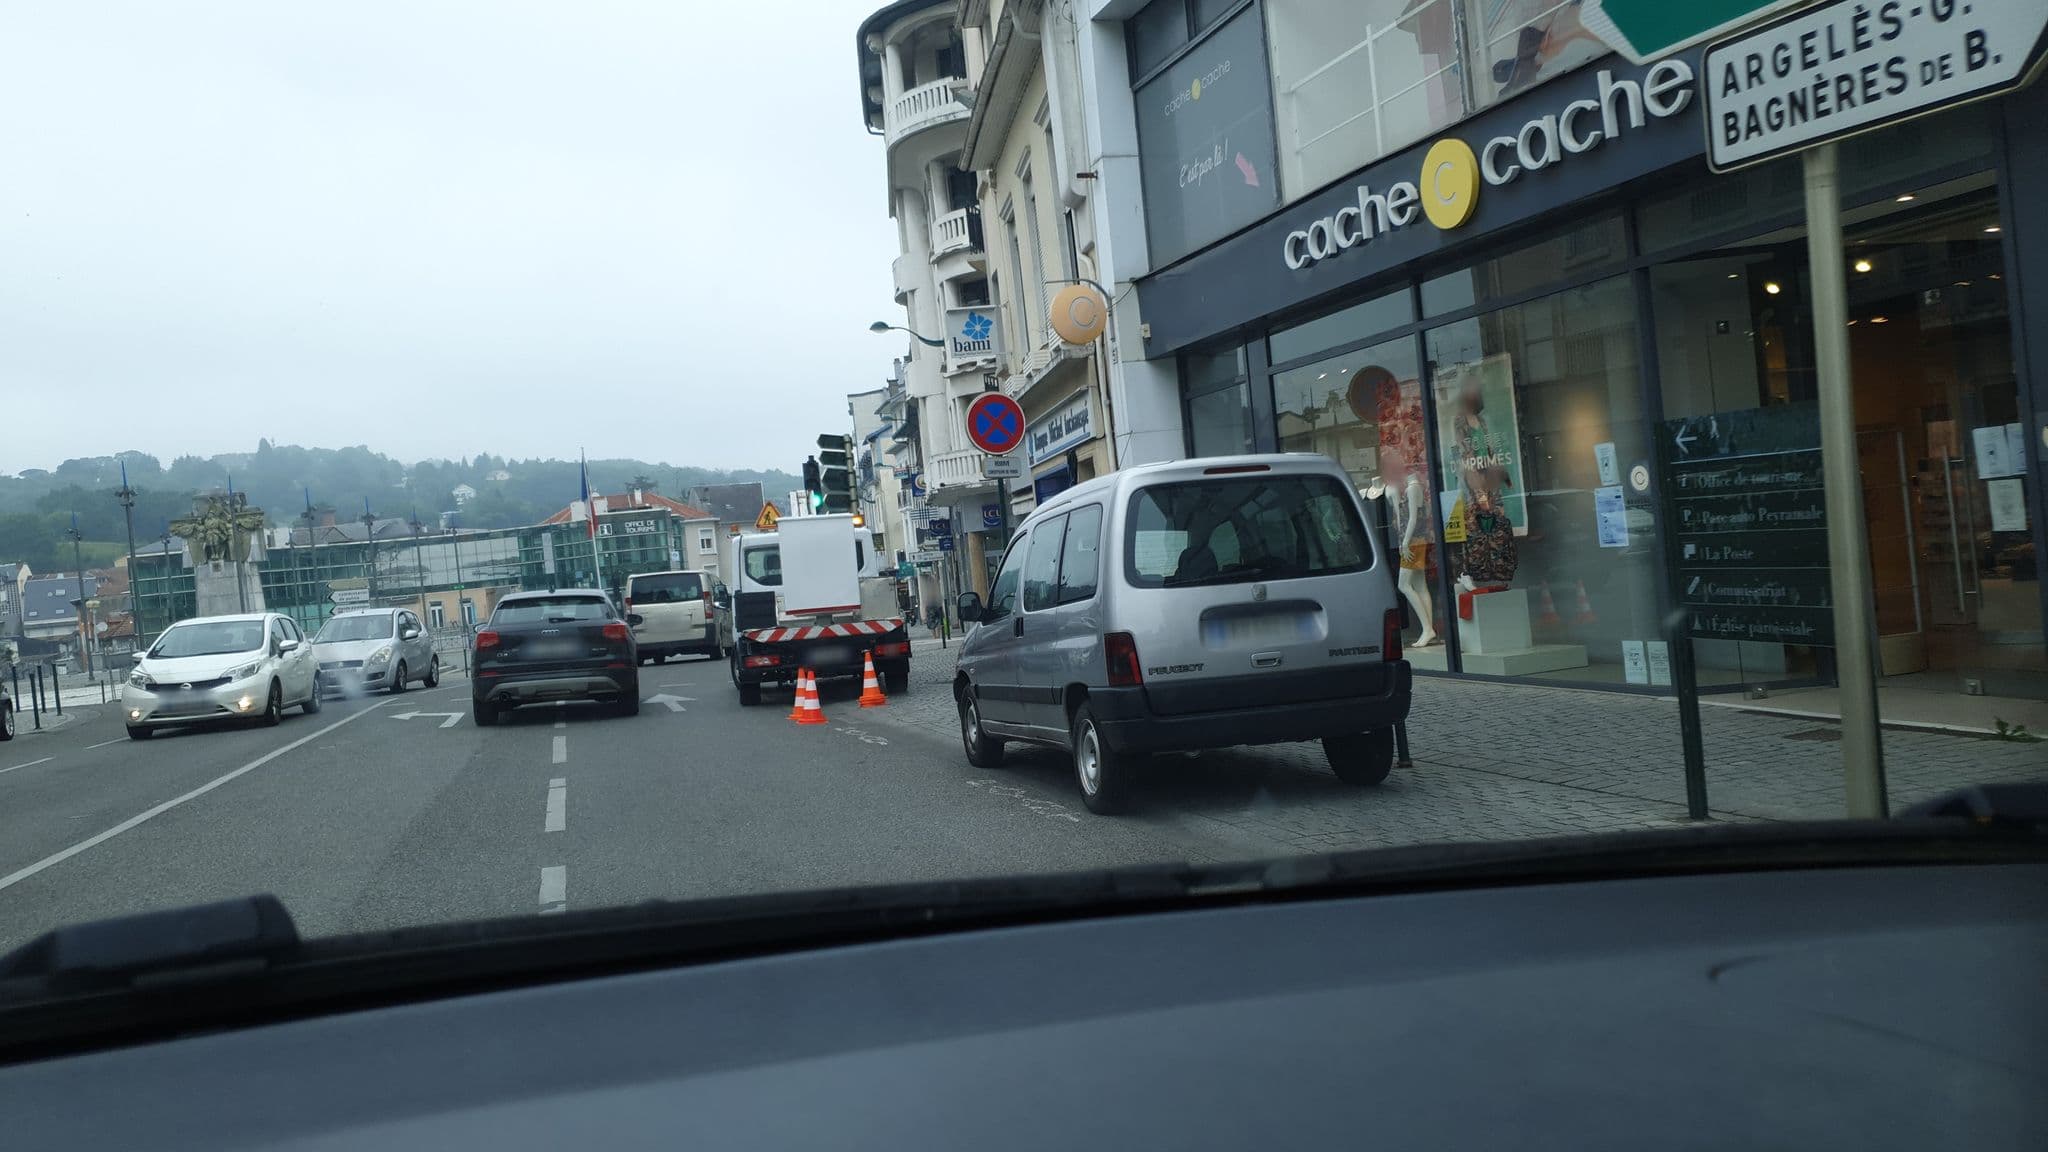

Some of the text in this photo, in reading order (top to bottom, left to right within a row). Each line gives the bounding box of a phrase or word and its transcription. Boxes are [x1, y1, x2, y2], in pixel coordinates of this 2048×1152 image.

[1164, 60, 1231, 116] cache cache
[1722, 28, 2002, 147] BAGNÈRES DE B.
[1283, 181, 1420, 270] cache
[1481, 59, 1694, 186] cache
[953, 335, 991, 353] bami
[983, 510, 1001, 518] LCL
[624, 520, 644, 528] OFFICE
[624, 526, 657, 534] TOURISME
[1705, 546, 1754, 561] La Poste
[1328, 645, 1381, 657] PARTNER
[1148, 663, 1204, 676] PEUGEOT
